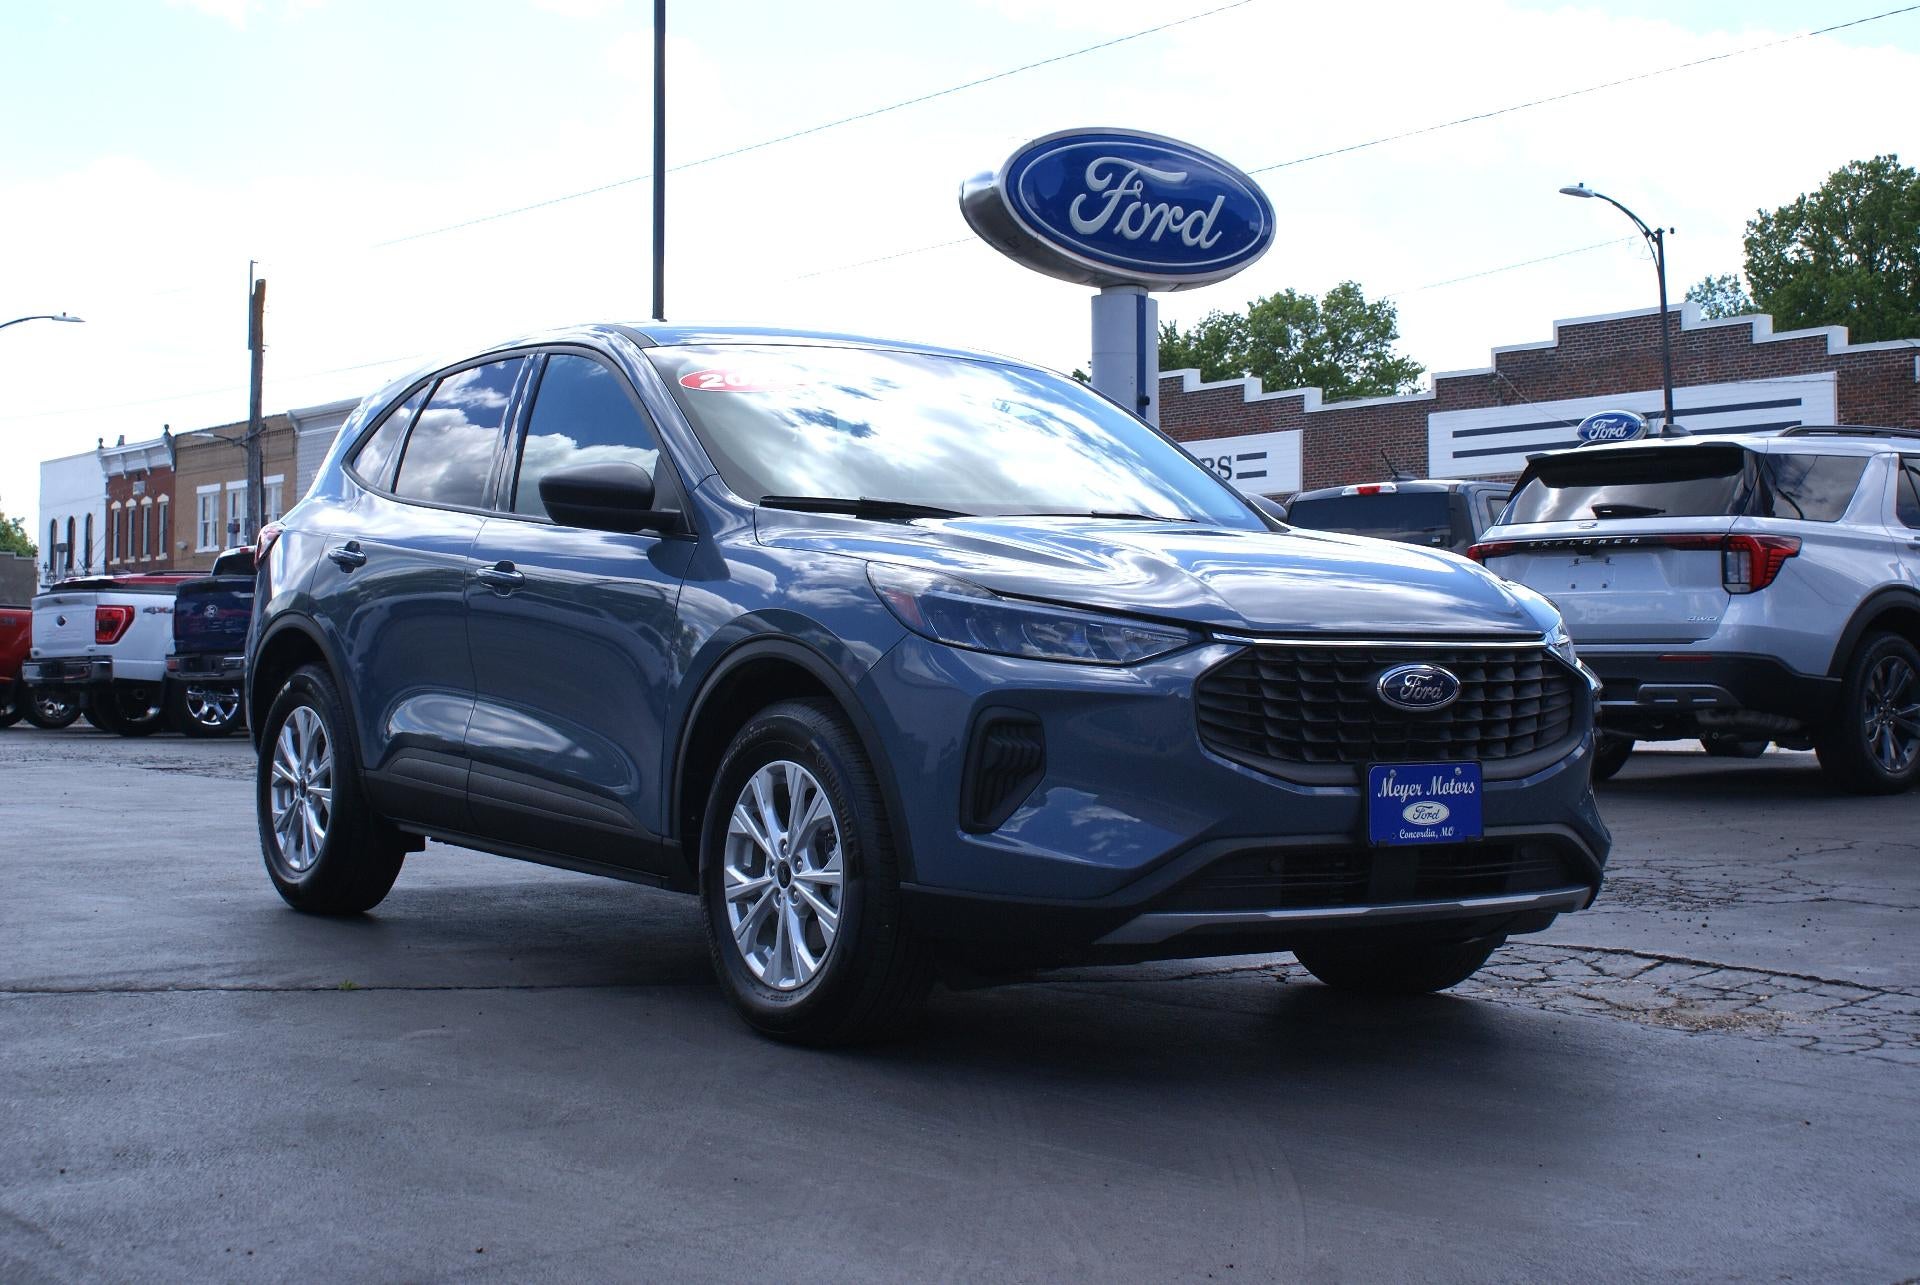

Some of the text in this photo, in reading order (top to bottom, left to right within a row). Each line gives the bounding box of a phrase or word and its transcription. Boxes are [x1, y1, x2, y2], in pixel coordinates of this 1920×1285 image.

[1069, 156, 1225, 249] Ford
[1588, 418, 1628, 440] Ford
[1528, 538, 1640, 547] EXPLORER
[1400, 674, 1444, 699] Ford
[1377, 775, 1475, 803] Meyer Motors
[1412, 805, 1440, 820] Ford
[1399, 826, 1455, 839] Concordia, MO
